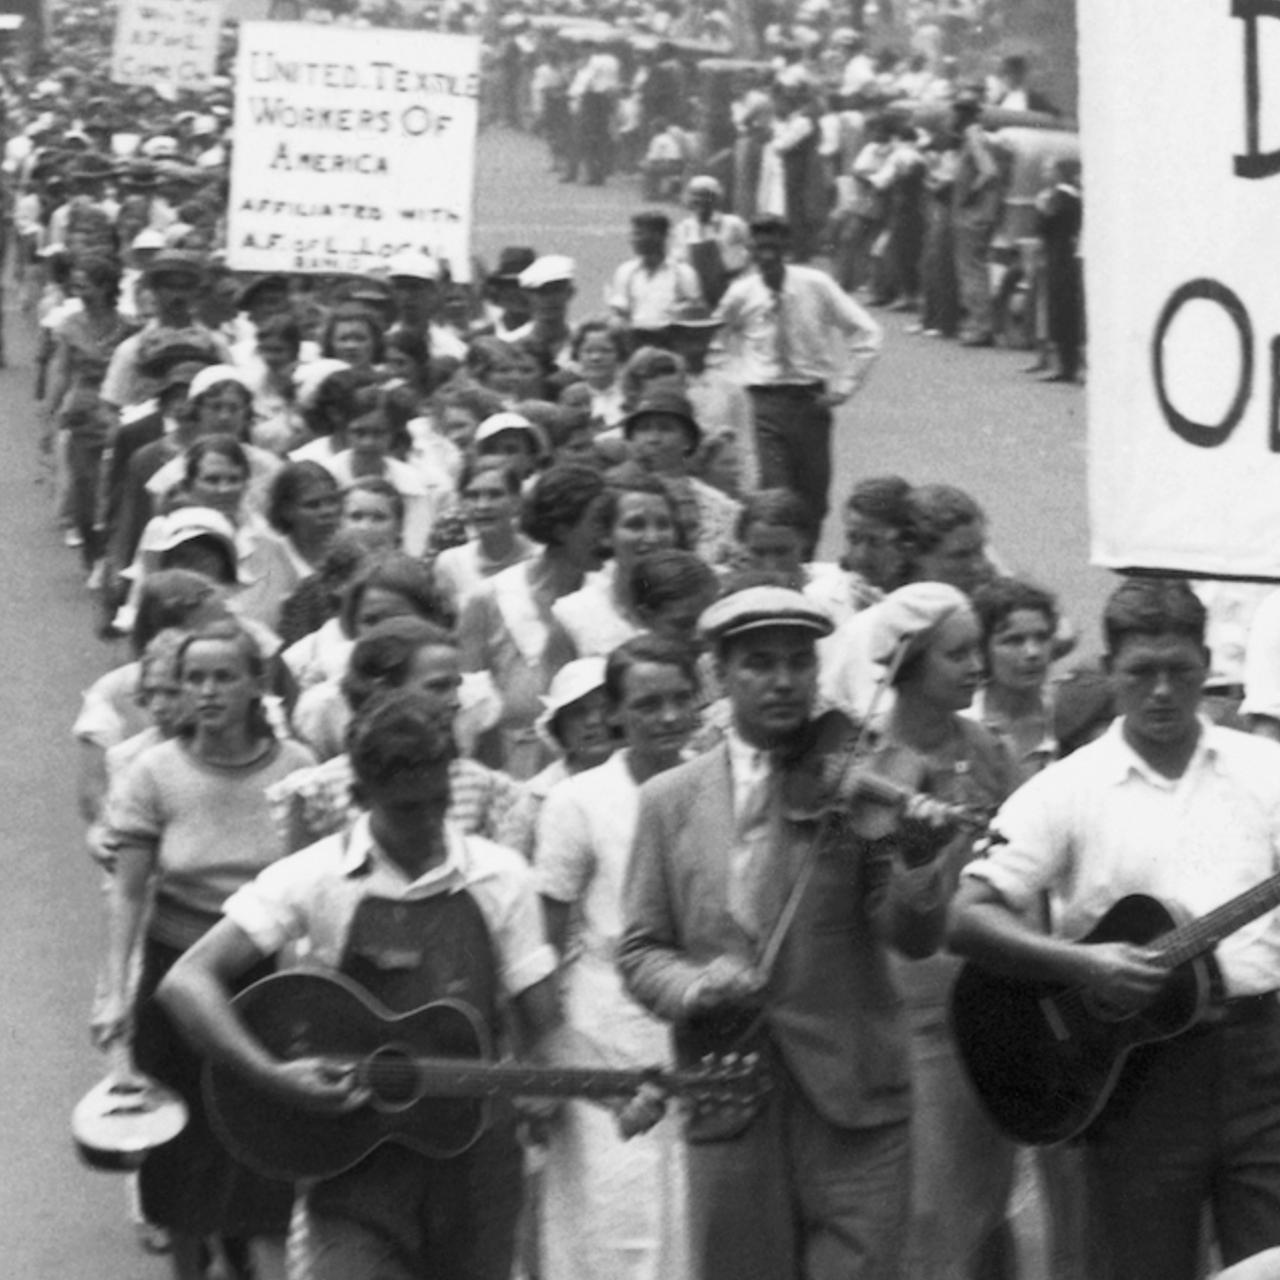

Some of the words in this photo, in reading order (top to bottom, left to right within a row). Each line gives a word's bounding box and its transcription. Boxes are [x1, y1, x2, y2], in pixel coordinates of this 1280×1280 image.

[250, 51, 358, 89] UNITED
[248, 96, 391, 134] WORKERS
[400, 104, 454, 138] OF
[269, 141, 389, 174] AMERICA
[240, 198, 384, 222] AFFILIATED
[398, 207, 462, 223] WITH
